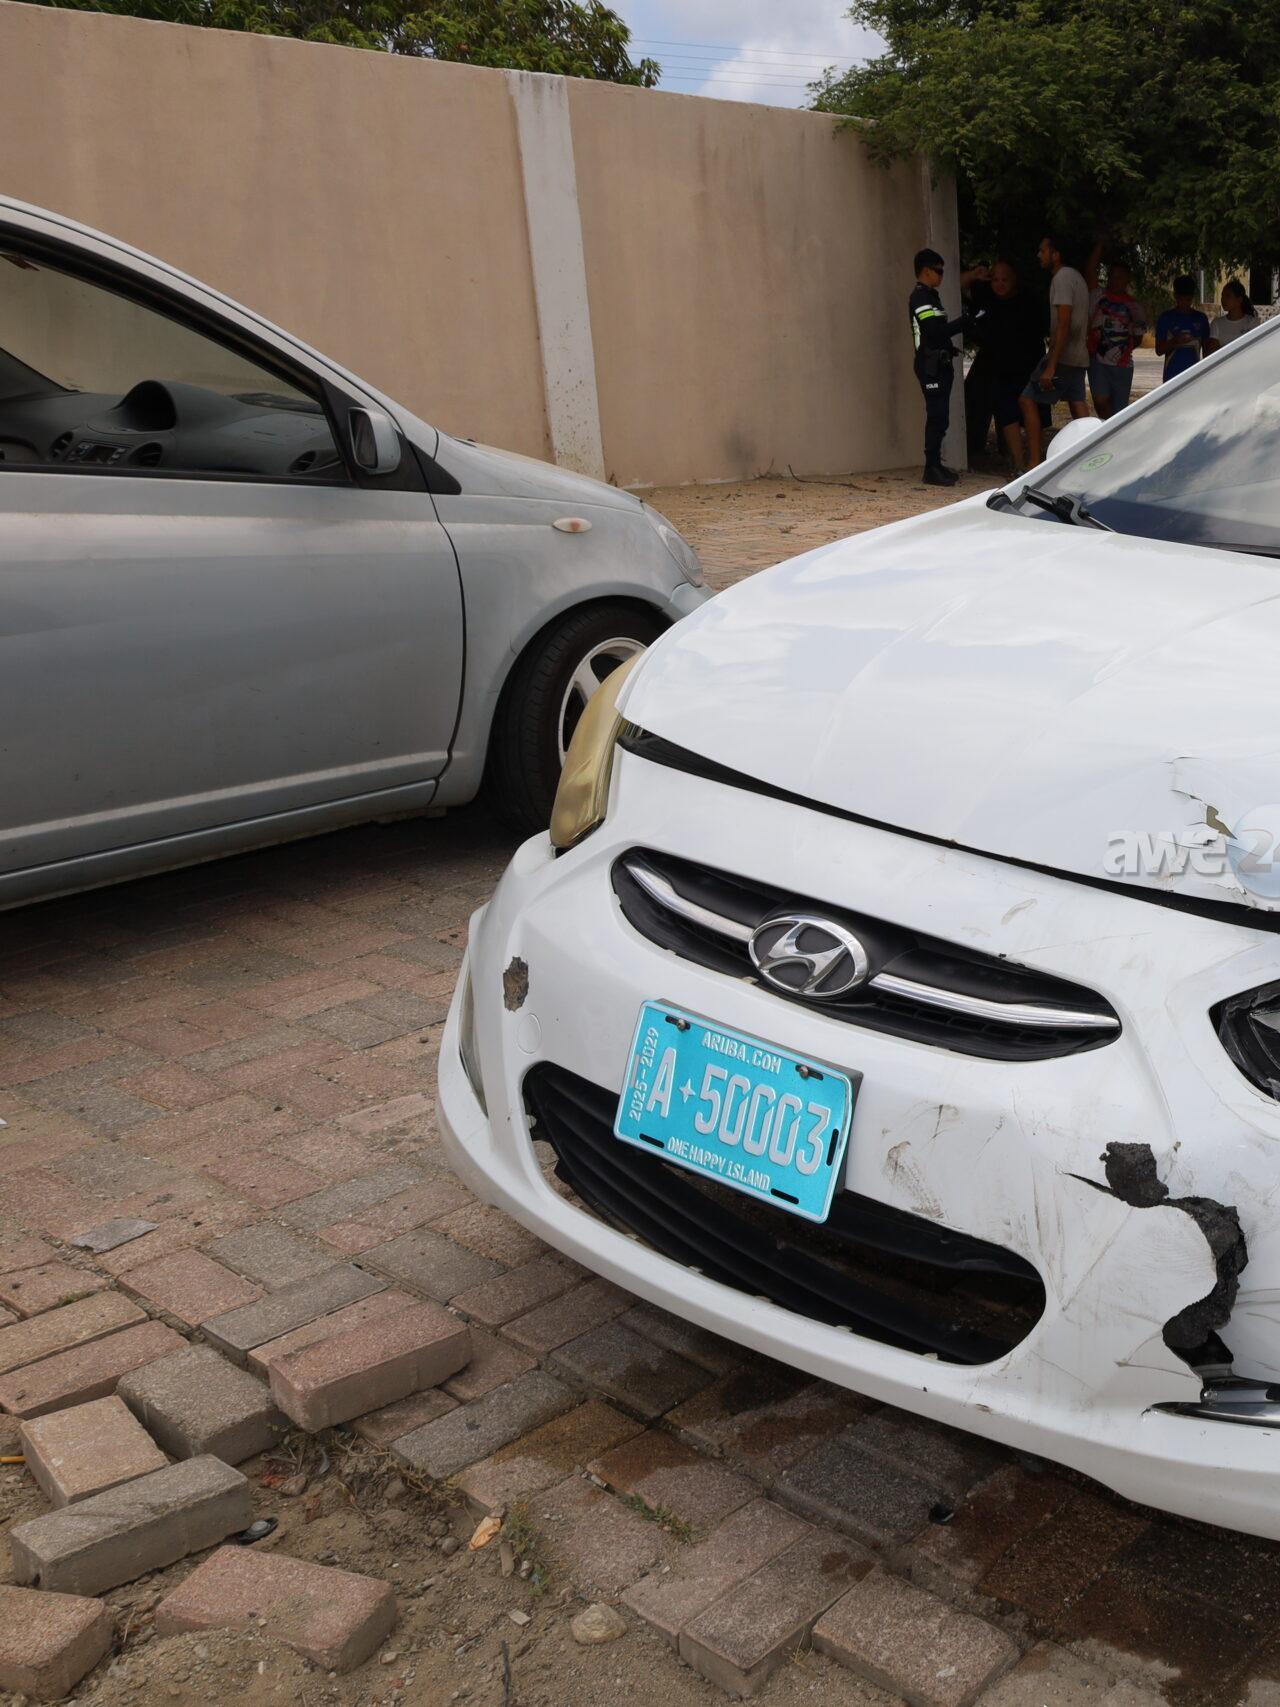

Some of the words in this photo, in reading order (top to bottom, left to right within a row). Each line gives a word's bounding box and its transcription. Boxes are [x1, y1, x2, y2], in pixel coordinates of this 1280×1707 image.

[629, 1027, 659, 1122] 2025-2029
[702, 1031, 782, 1074] ARUBA.COM
[667, 1136, 690, 1157] ONE
[690, 1146, 726, 1173] HAPPY
[726, 1160, 771, 1190] ISLAND
